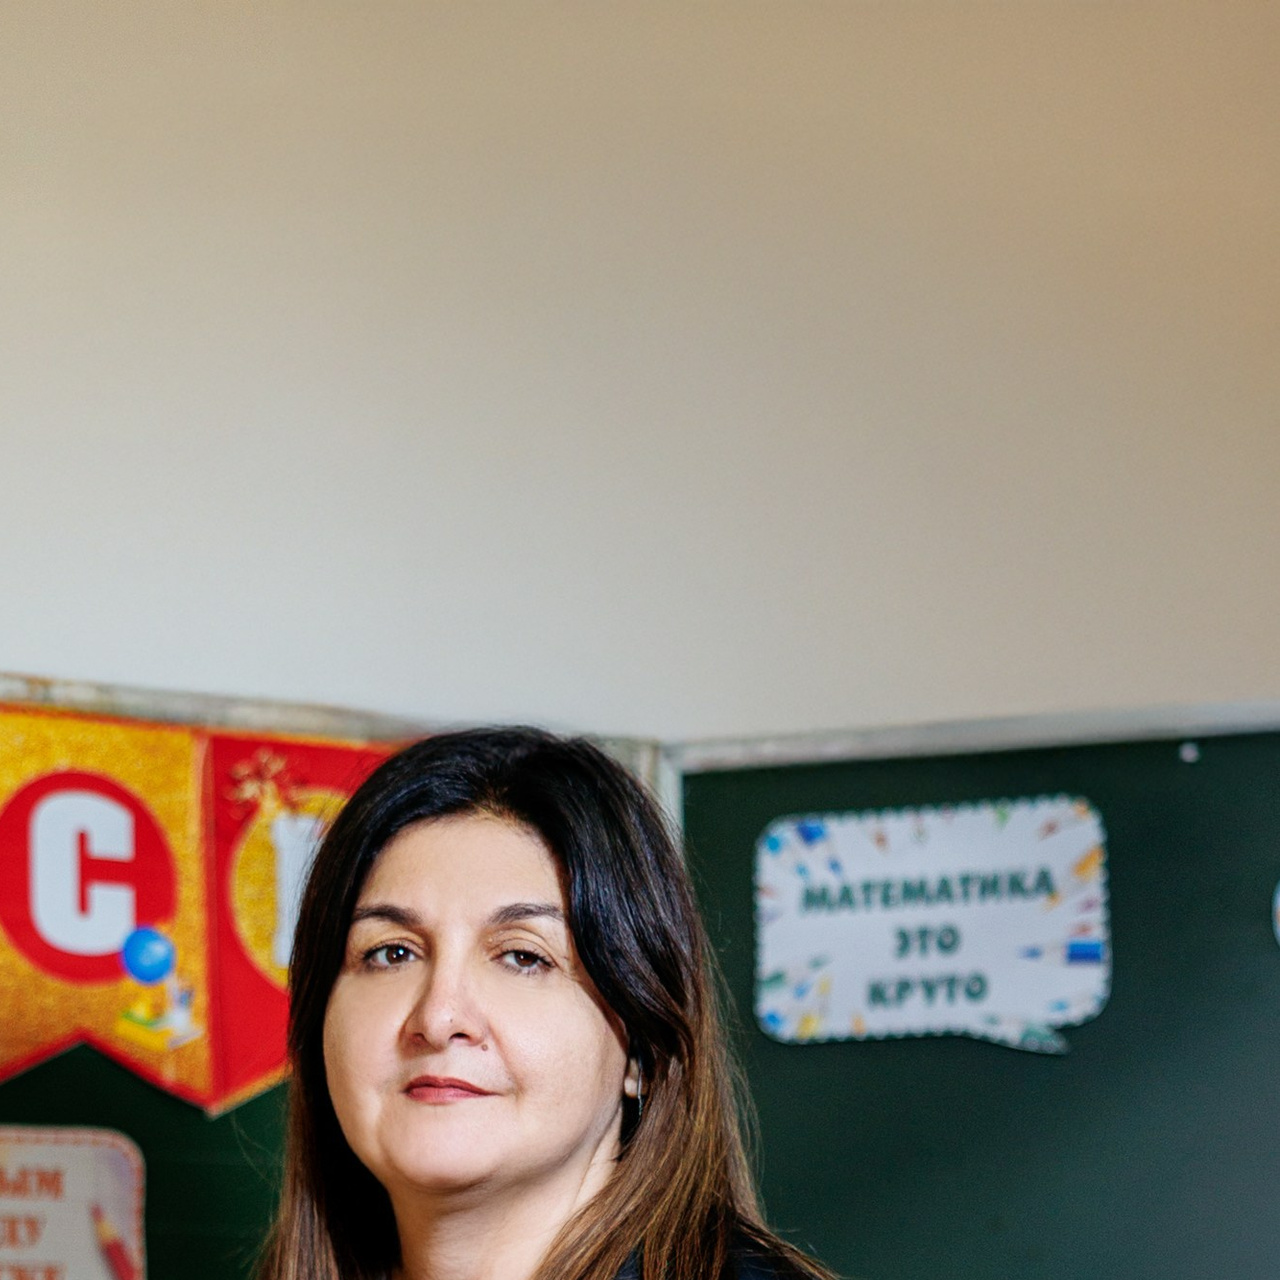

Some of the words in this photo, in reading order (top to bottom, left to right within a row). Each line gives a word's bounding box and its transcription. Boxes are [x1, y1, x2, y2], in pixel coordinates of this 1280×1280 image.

[803, 867, 1054, 910] МАТЕМАТИКА
[895, 925, 960, 958] ЭТО
[867, 973, 988, 1006] КРУТО
